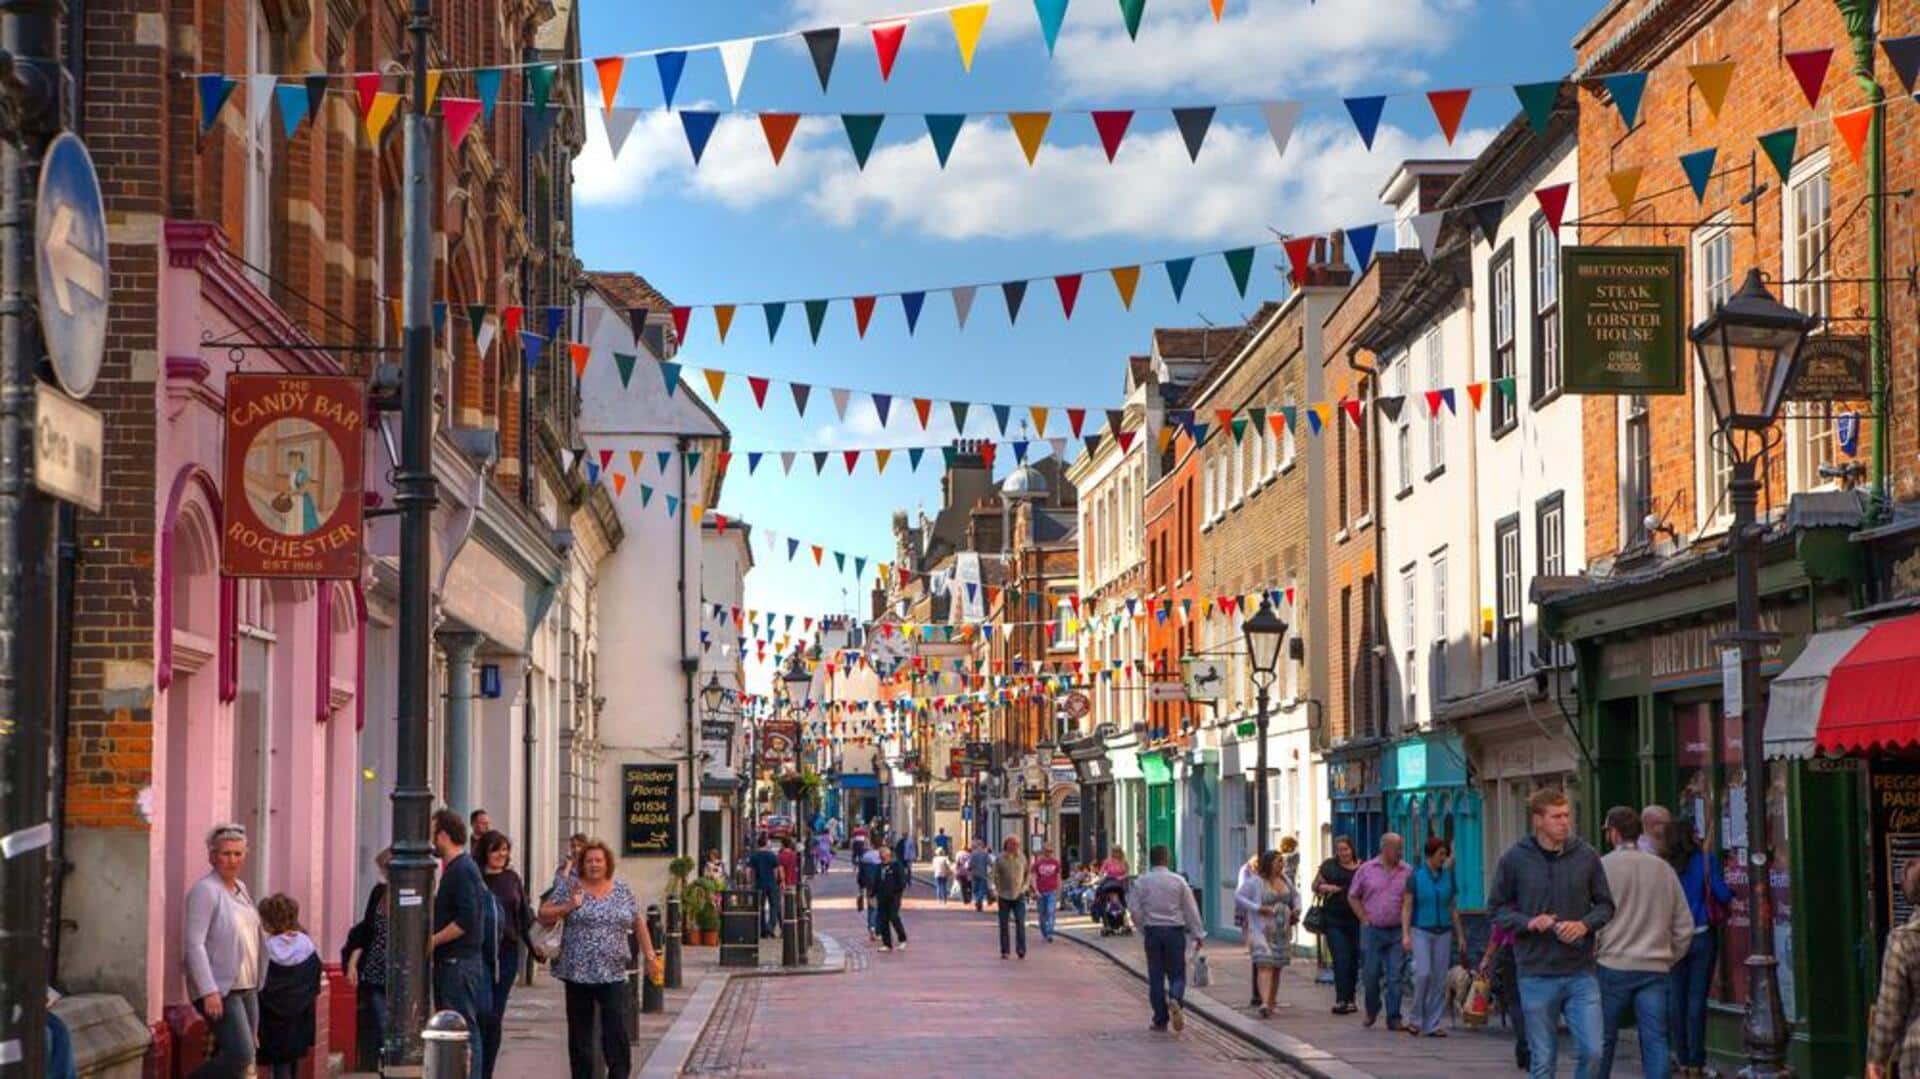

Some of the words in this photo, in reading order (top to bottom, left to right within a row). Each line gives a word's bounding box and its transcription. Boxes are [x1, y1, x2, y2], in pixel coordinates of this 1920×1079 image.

[1578, 265, 1670, 277] BRETTINGTONS
[1596, 286, 1650, 298] STEAK
[1611, 301, 1640, 311] AND
[1587, 313, 1661, 327] LOBSTER
[1596, 328, 1655, 341] HOUSE
[279, 380, 310, 391] THE
[232, 392, 310, 427] CANDY
[314, 395, 359, 431] BAR
[228, 521, 357, 558] ROCHESTER
[262, 560, 289, 569] EST
[1874, 775, 1920, 789] PEGG
[631, 785, 669, 796] Florist
[633, 802, 668, 812] 01634
